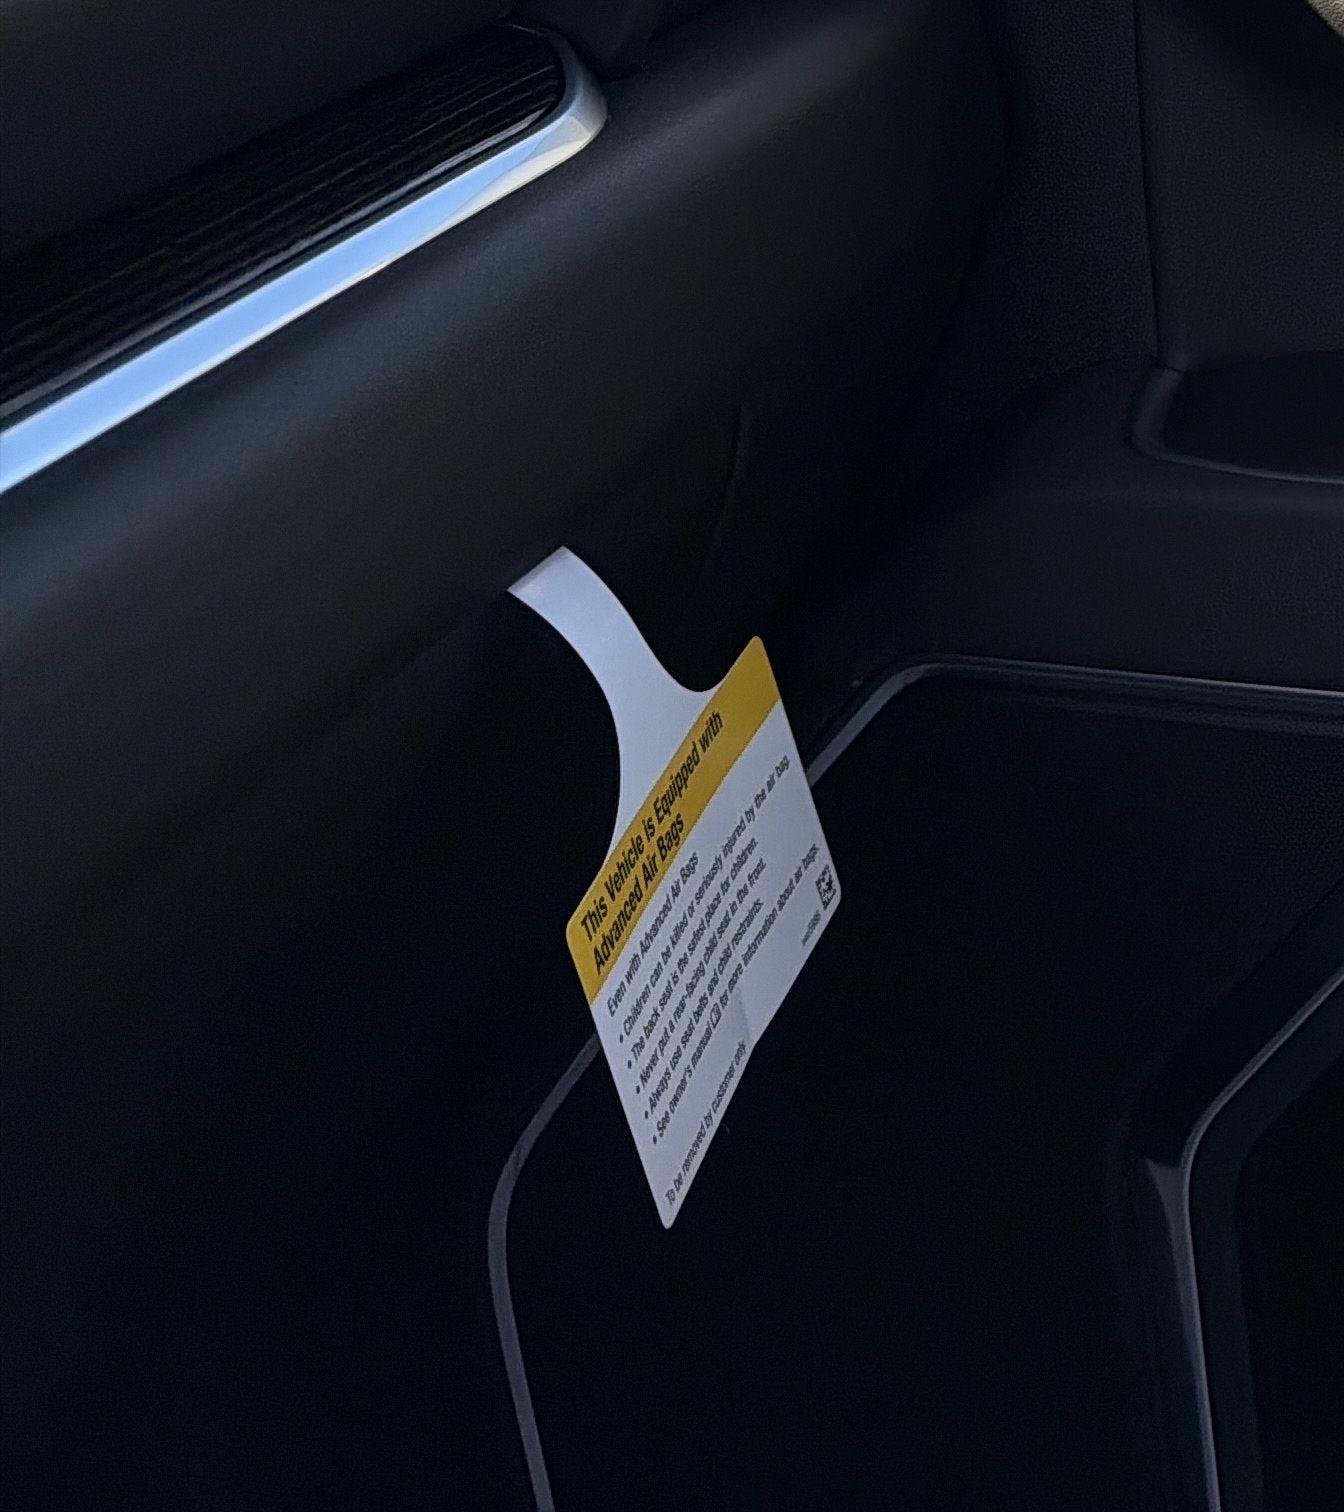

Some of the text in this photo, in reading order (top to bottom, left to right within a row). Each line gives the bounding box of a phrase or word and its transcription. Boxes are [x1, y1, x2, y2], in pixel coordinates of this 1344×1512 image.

[580, 711, 723, 942] This Vehicle is Equipped with
[592, 812, 684, 976] Advanced Air Bags
[606, 851, 698, 1017] Even with Advanced Air Bags
